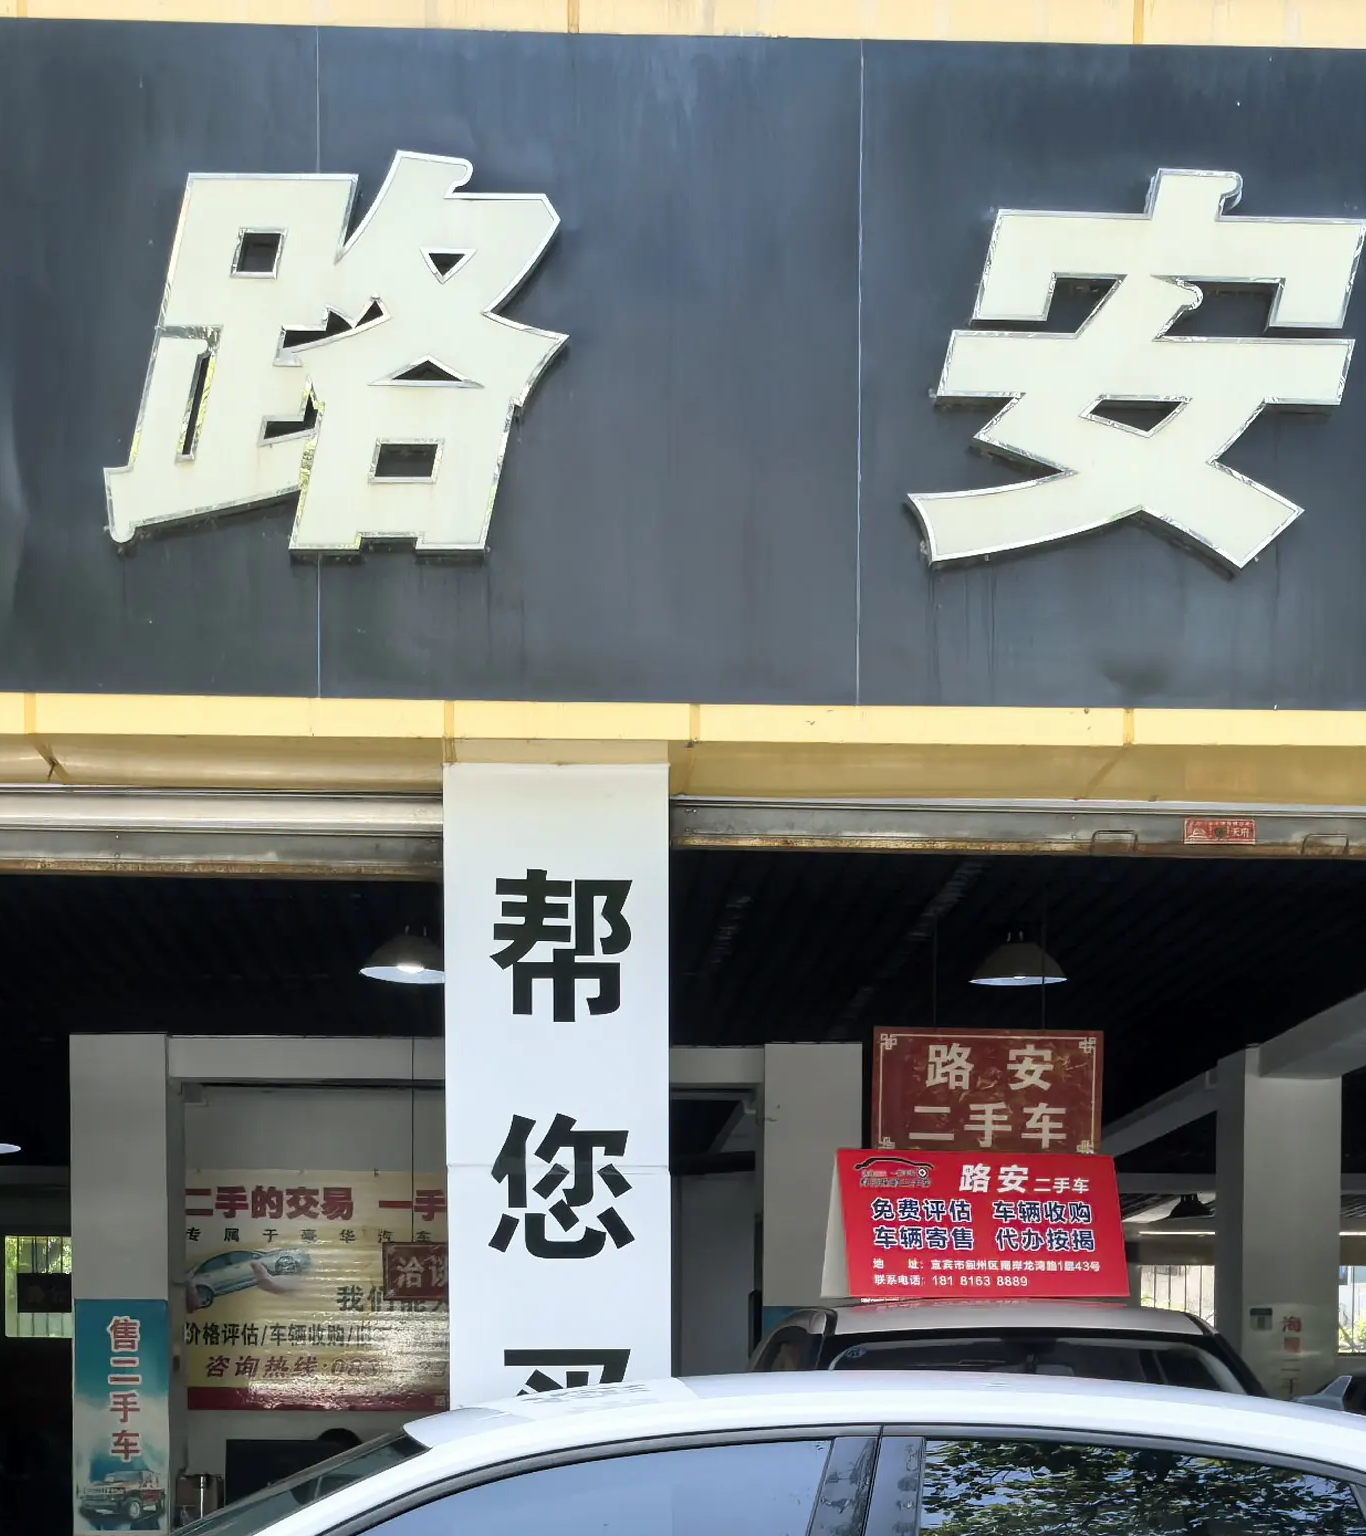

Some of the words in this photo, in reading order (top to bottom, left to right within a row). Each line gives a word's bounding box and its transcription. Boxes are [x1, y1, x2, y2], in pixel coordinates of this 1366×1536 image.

[925, 1043, 1055, 1092] 路安
[908, 1102, 1067, 1149] 二手车
[957, 1162, 1091, 1195] 路安二手车
[185, 1185, 355, 1221] 二手的交易
[871, 1197, 973, 1223] 免费评估
[992, 1200, 1093, 1225] 车辆收购
[872, 1225, 975, 1251] 车辆寄售
[994, 1226, 1097, 1252] 代办按揭
[931, 1275, 954, 1287] 181
[959, 1275, 992, 1287] 8163
[996, 1275, 1029, 1287] 8889
[107, 1315, 142, 1463] 售二手车
